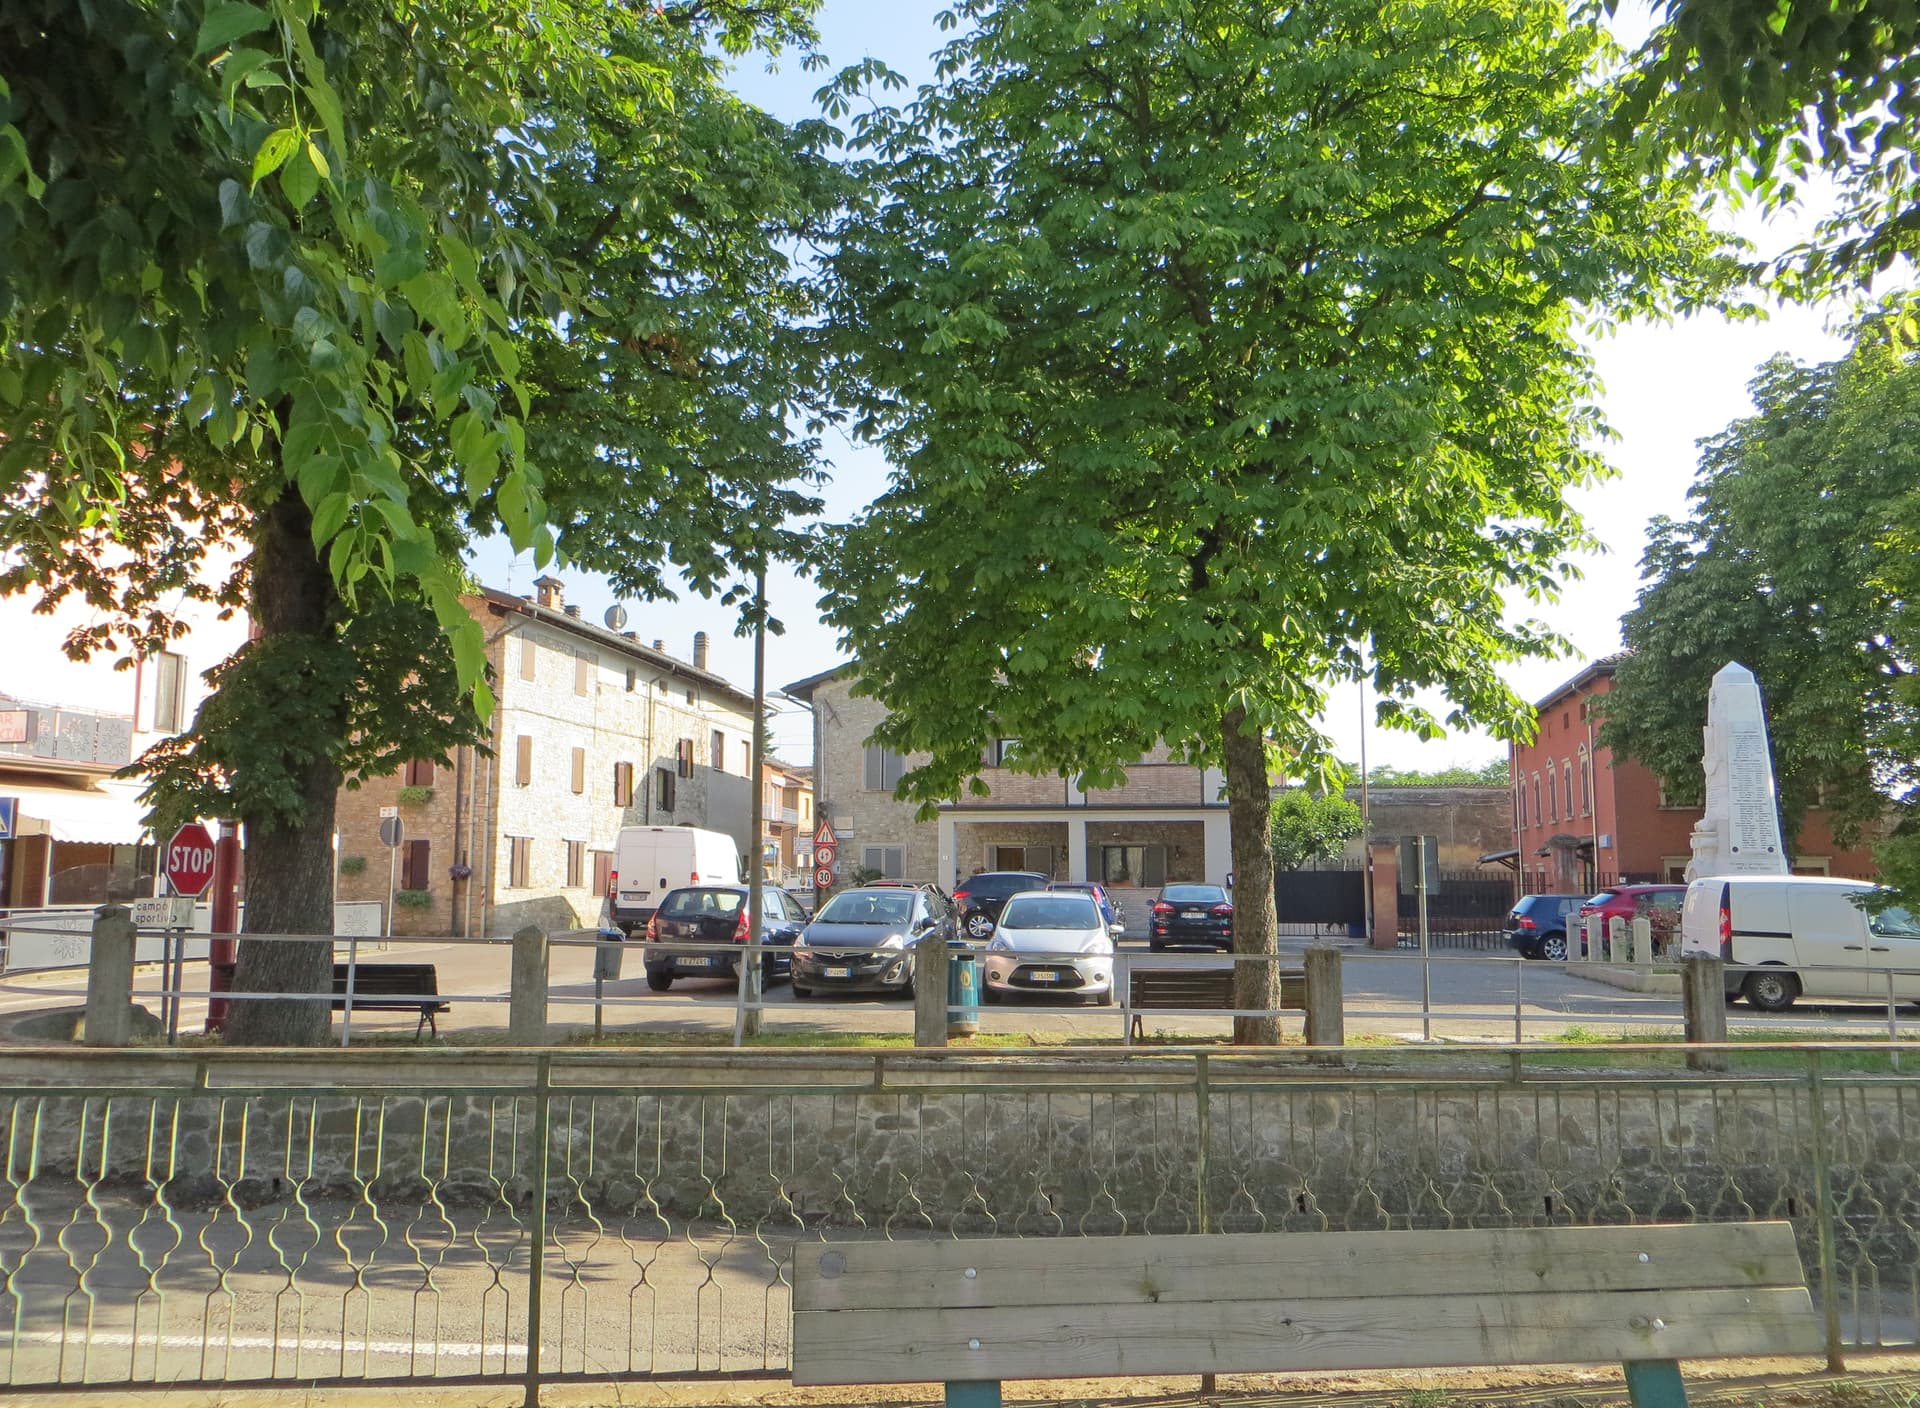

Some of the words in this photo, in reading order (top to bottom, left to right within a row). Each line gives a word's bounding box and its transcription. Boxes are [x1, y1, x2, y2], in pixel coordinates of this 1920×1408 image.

[170, 846, 213, 874] STOP
[819, 872, 830, 882] 30
[136, 902, 169, 913] campo
